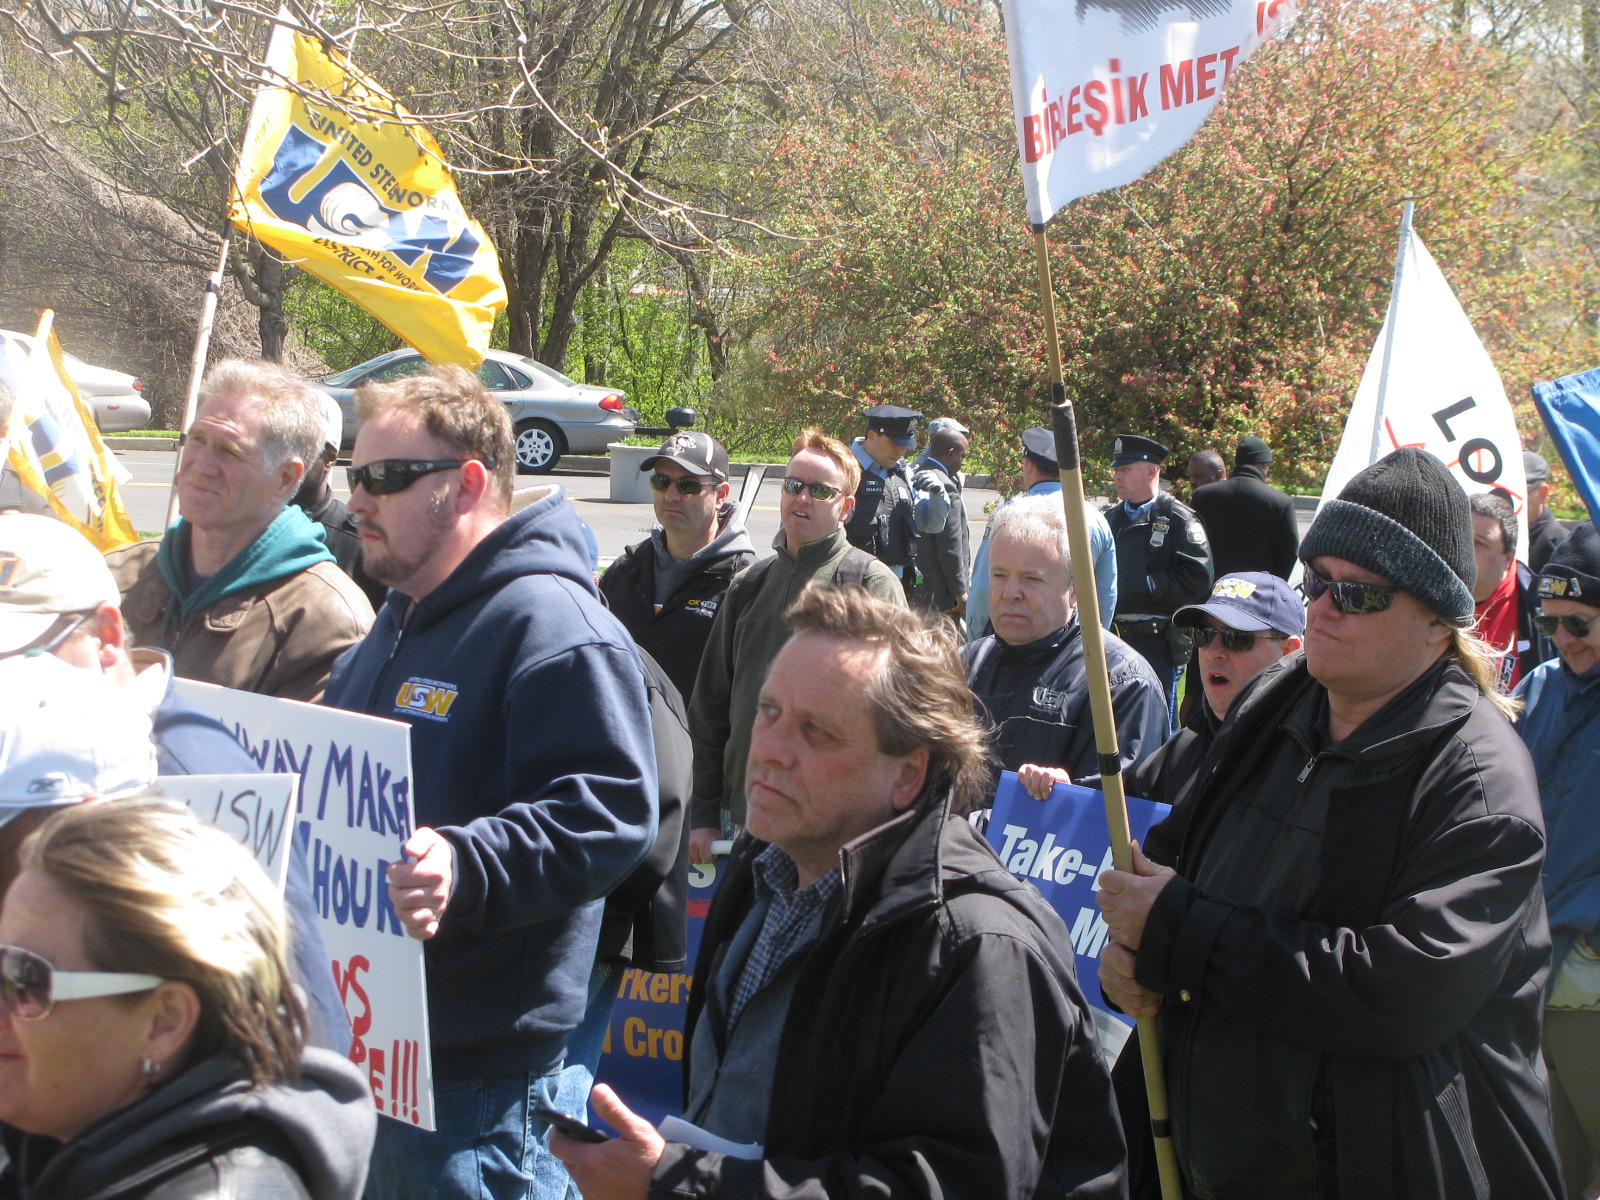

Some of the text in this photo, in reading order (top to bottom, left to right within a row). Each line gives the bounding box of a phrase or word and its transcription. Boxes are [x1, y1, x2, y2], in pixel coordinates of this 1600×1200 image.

[309, 116, 374, 168] UNITED
[378, 256, 398, 274] FOR
[1538, 577, 1568, 596] SW
[395, 681, 459, 717] USW
[999, 823, 1116, 892] Take-
[623, 1016, 683, 1061] Cro
